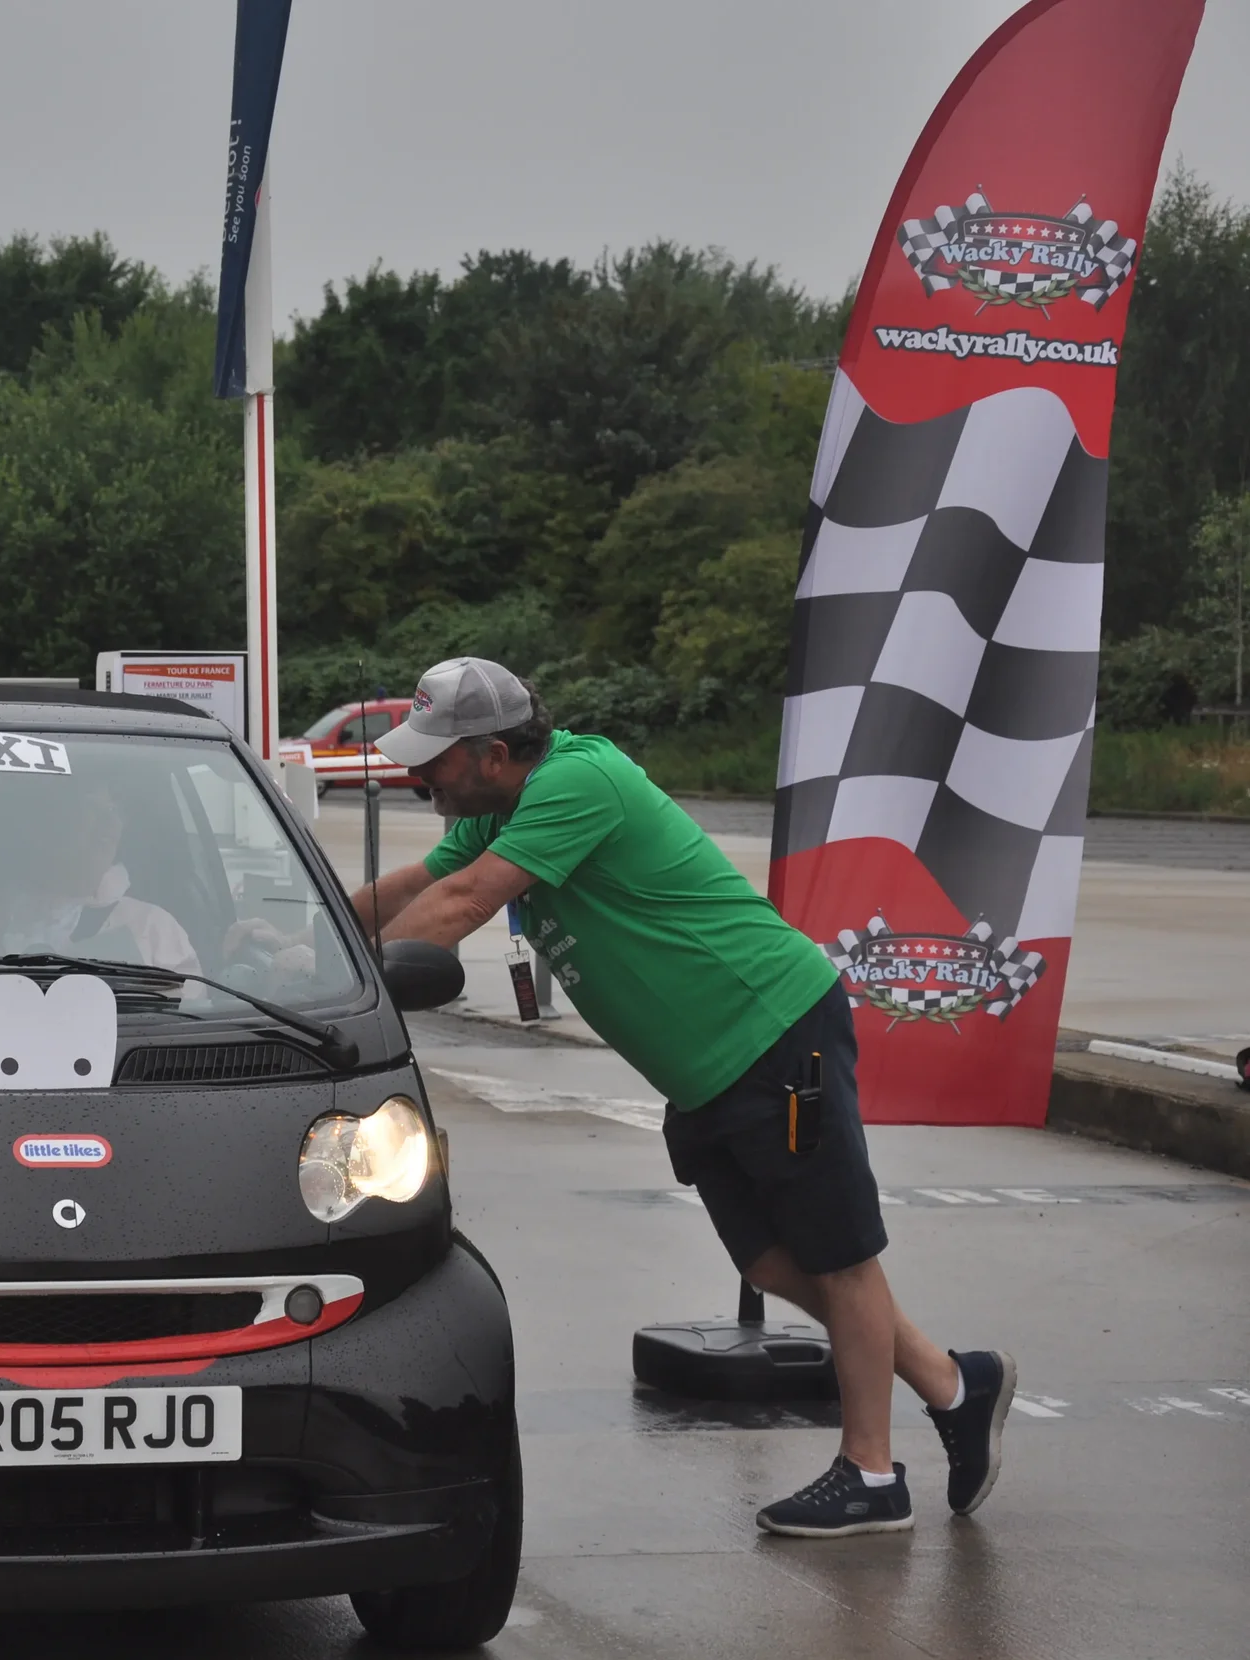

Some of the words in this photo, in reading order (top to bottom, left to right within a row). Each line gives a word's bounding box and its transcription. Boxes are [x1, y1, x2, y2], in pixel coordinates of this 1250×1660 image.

[240, 145, 252, 182] soon
[235, 185, 246, 212] you
[228, 216, 240, 243] See
[940, 241, 1025, 265] Wacky
[1030, 244, 1100, 278] Rally
[875, 326, 1119, 366] wackyrally.co.uk
[143, 681, 183, 690] FERMETURE
[185, 681, 196, 689] DU
[197, 681, 215, 689] PARC
[167, 667, 188, 675] TOUR
[189, 667, 199, 675] DE
[201, 667, 230, 675] FRANCE
[845, 959, 931, 984] Wacky
[936, 962, 1003, 993] Rally
[24, 1144, 61, 1157] little
[63, 1144, 102, 1157] tikes
[103, 1394, 215, 1450] RJO
